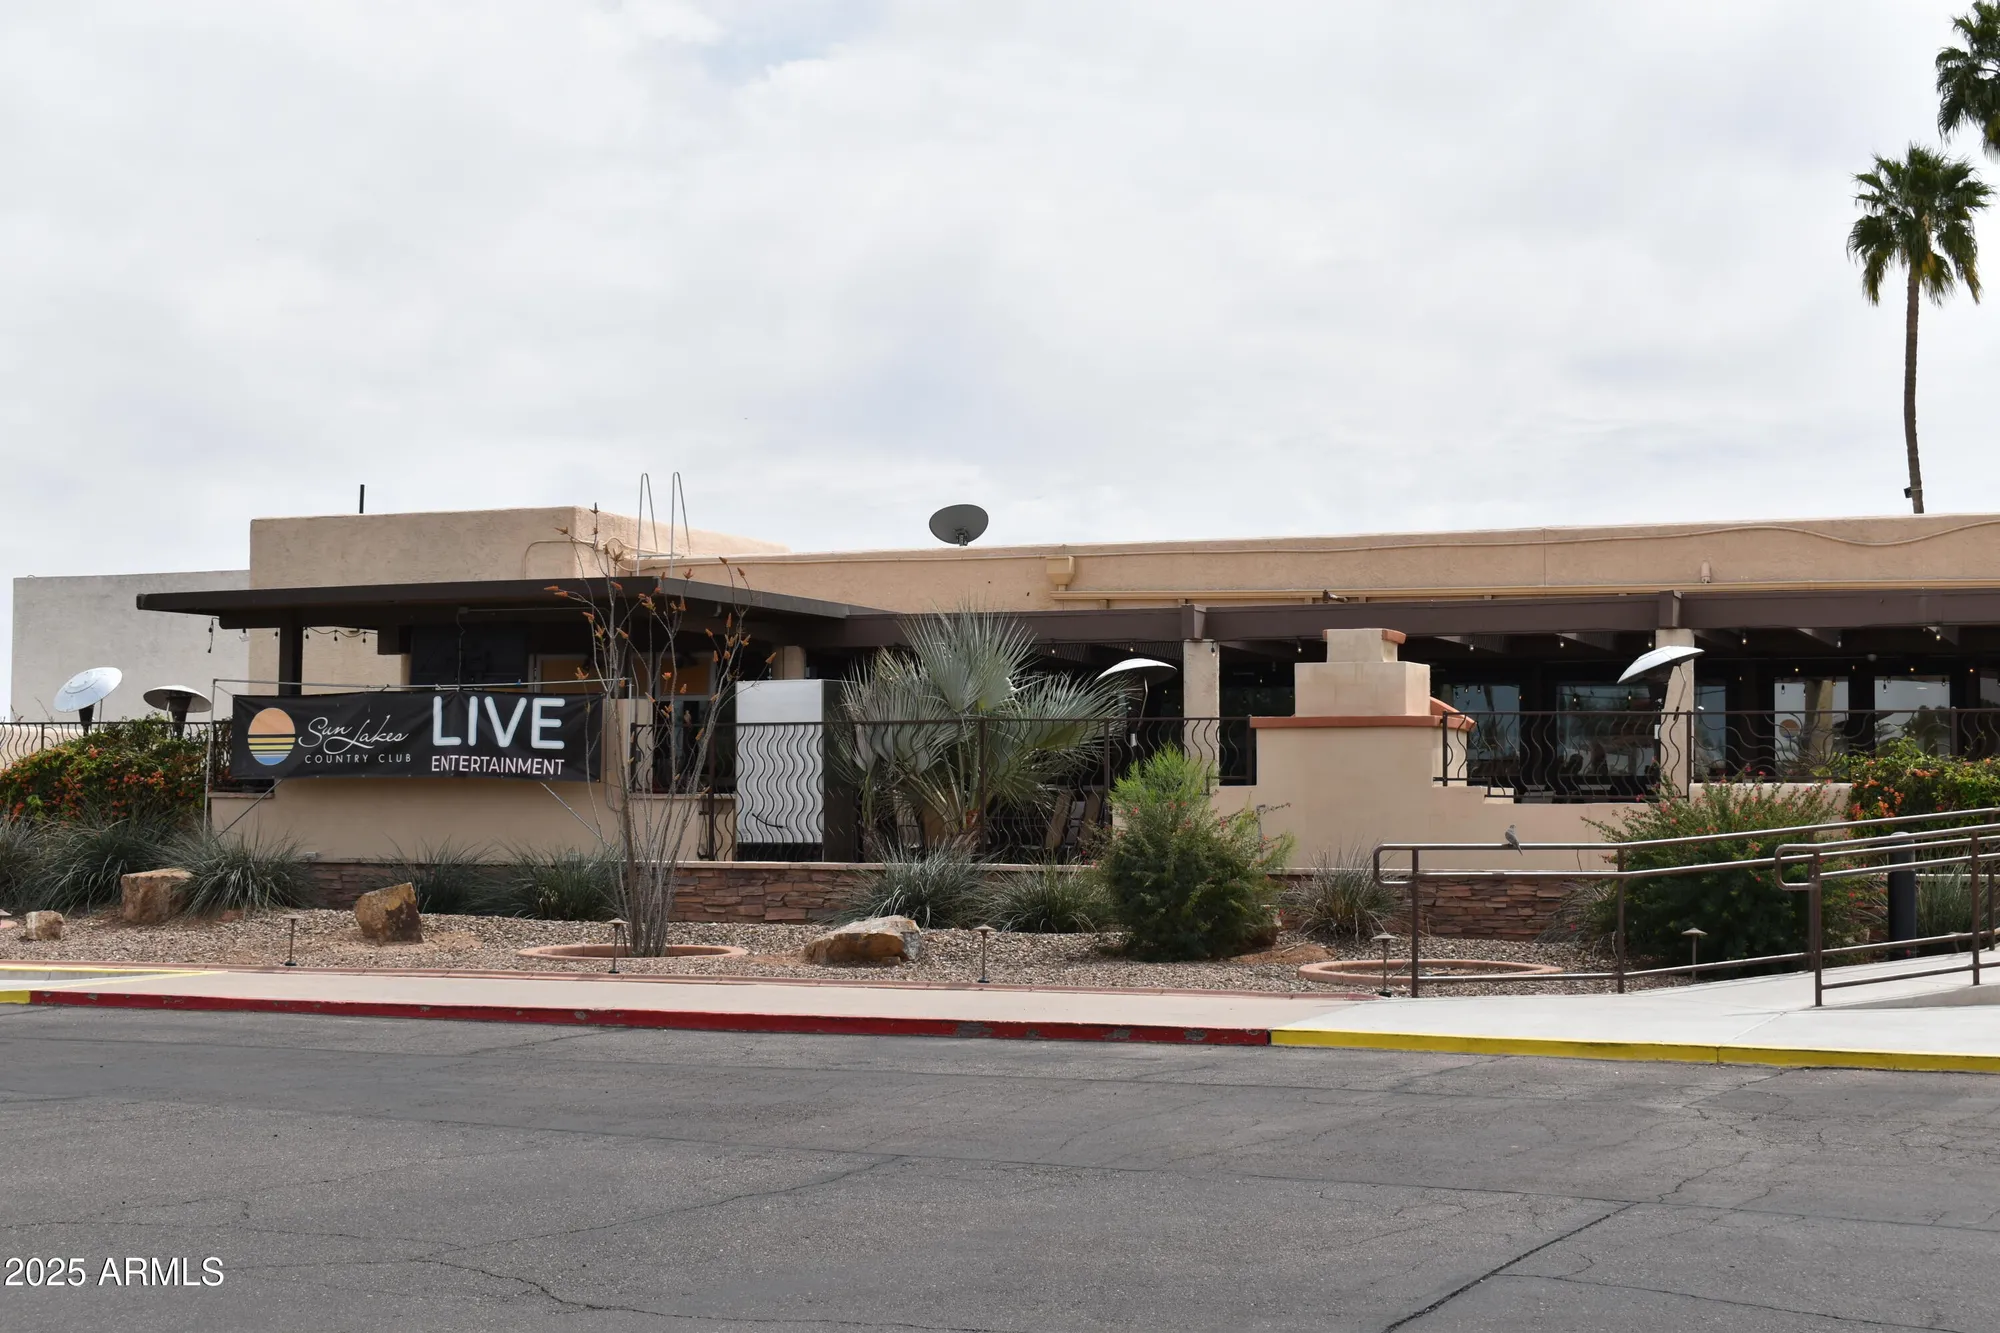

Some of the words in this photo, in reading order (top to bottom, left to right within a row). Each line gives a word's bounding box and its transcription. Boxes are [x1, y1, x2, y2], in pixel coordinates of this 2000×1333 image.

[298, 716, 352, 748] Sun
[323, 714, 409, 754] Lakes
[432, 695, 566, 749] LIVE
[304, 754, 369, 764] COUNTRY
[378, 753, 411, 763] CLUB
[431, 755, 565, 775] ENTERTAINMENT
